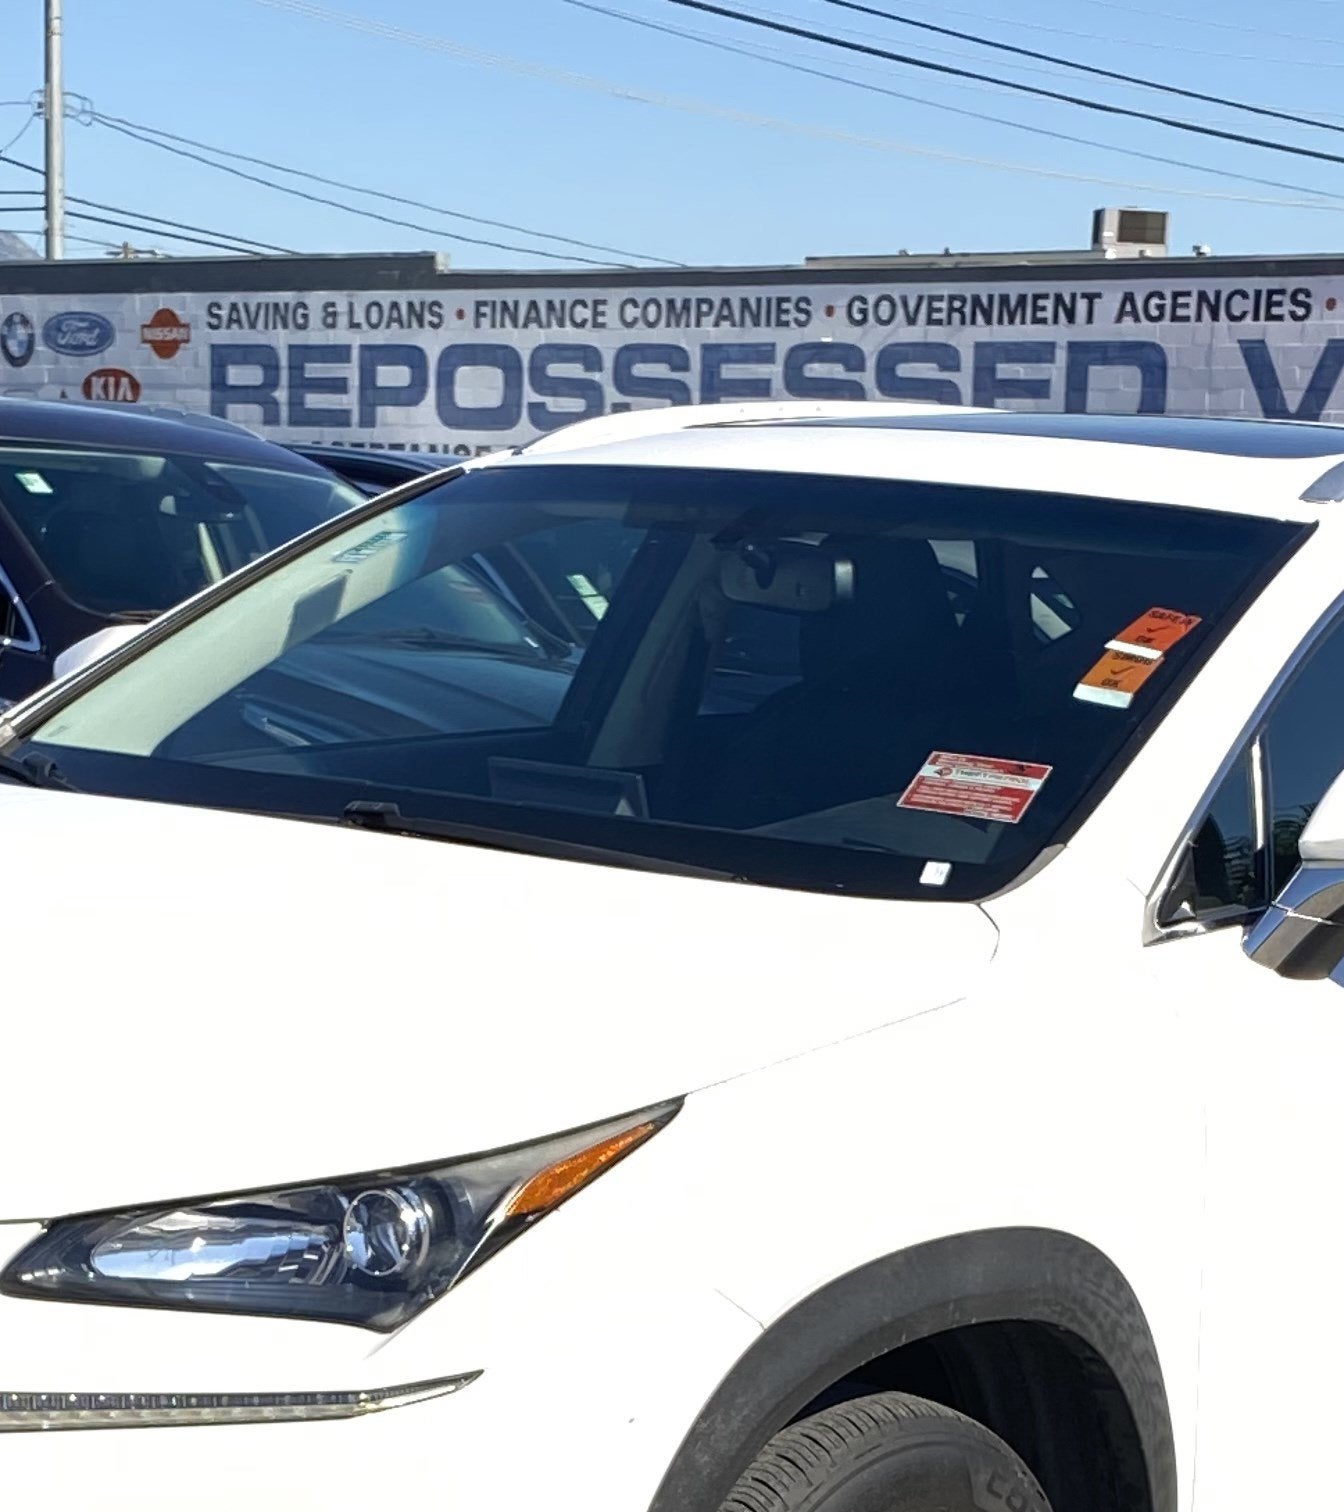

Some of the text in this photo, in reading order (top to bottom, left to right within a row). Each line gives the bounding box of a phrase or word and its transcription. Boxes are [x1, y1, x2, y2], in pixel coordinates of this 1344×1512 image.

[207, 301, 309, 330] SAVING
[322, 301, 337, 329] &
[348, 300, 445, 329] LOANS
[473, 298, 607, 329] FINANCE
[619, 296, 813, 328] COMPANIES
[846, 291, 1102, 326] GOVERNMENT
[1114, 287, 1313, 323] AGENCIES
[56, 320, 101, 346] Ford
[90, 376, 134, 400] KIA
[210, 340, 1169, 432] REPOSSESSED
